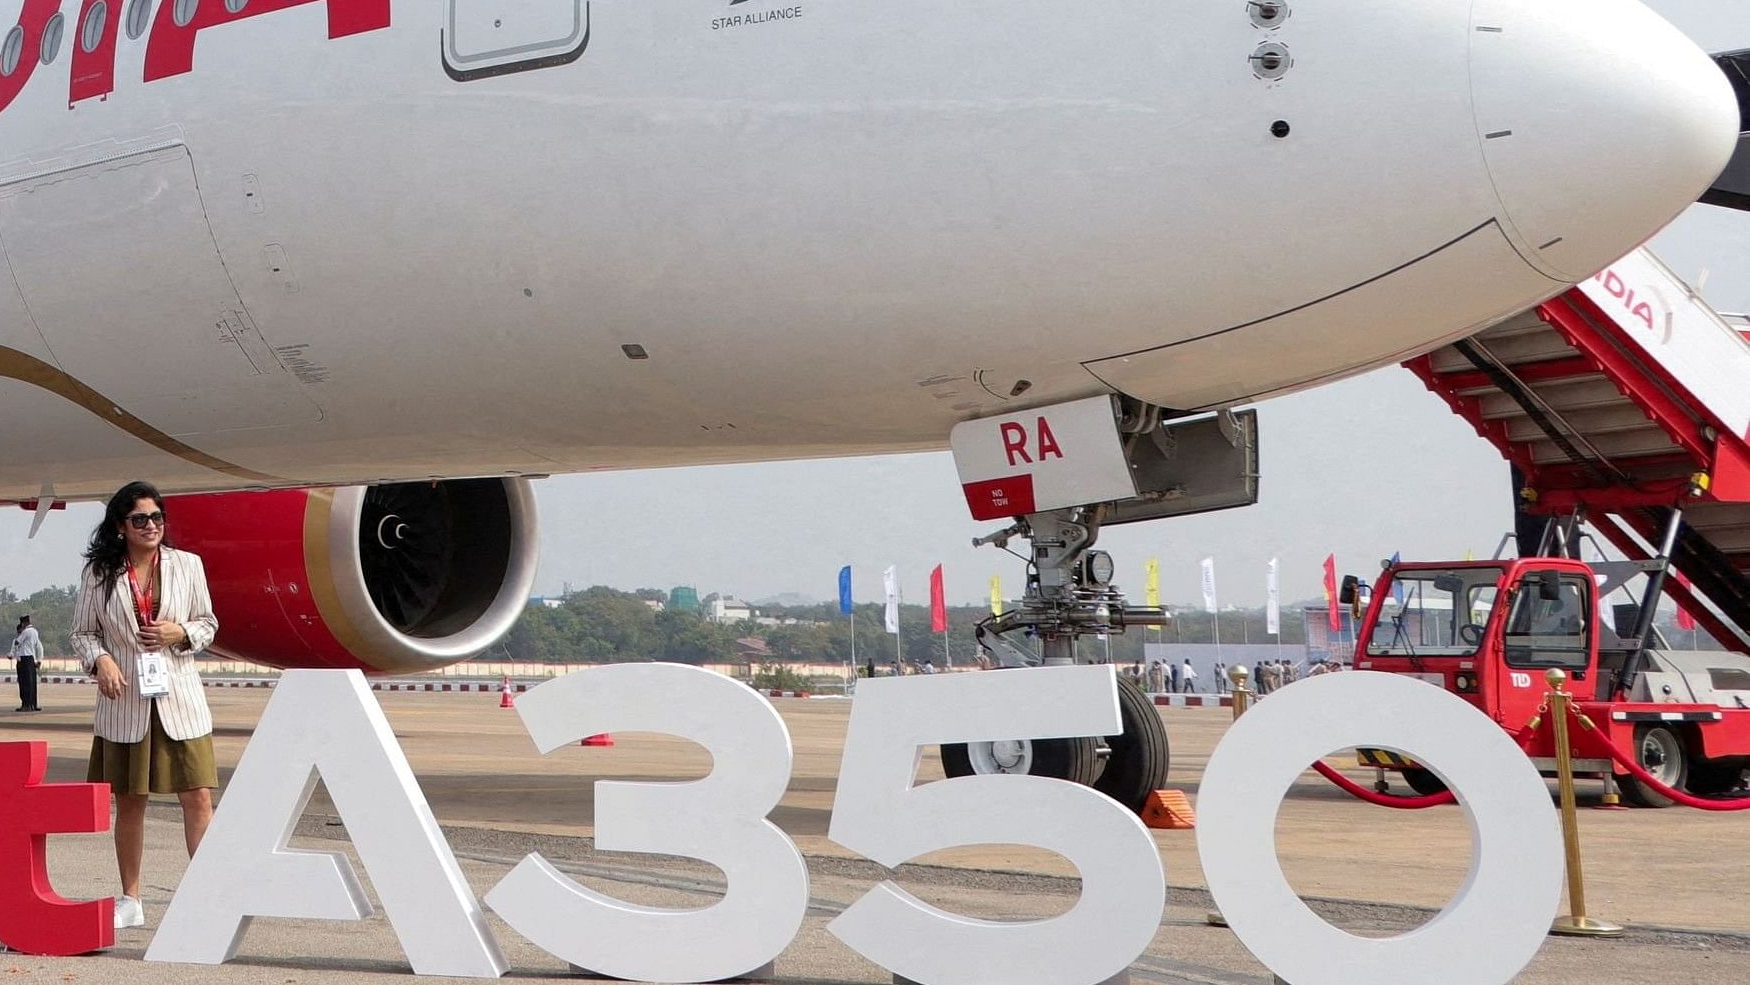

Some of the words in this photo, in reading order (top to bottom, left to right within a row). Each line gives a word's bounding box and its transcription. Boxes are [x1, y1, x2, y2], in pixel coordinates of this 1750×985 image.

[711, 16, 742, 30] STAR
[744, 6, 803, 25] ALLIANCE
[999, 416, 1064, 466] RA
[992, 489, 1003, 497] NO
[992, 497, 1008, 506] TOW
[144, 661, 1566, 985] A350
